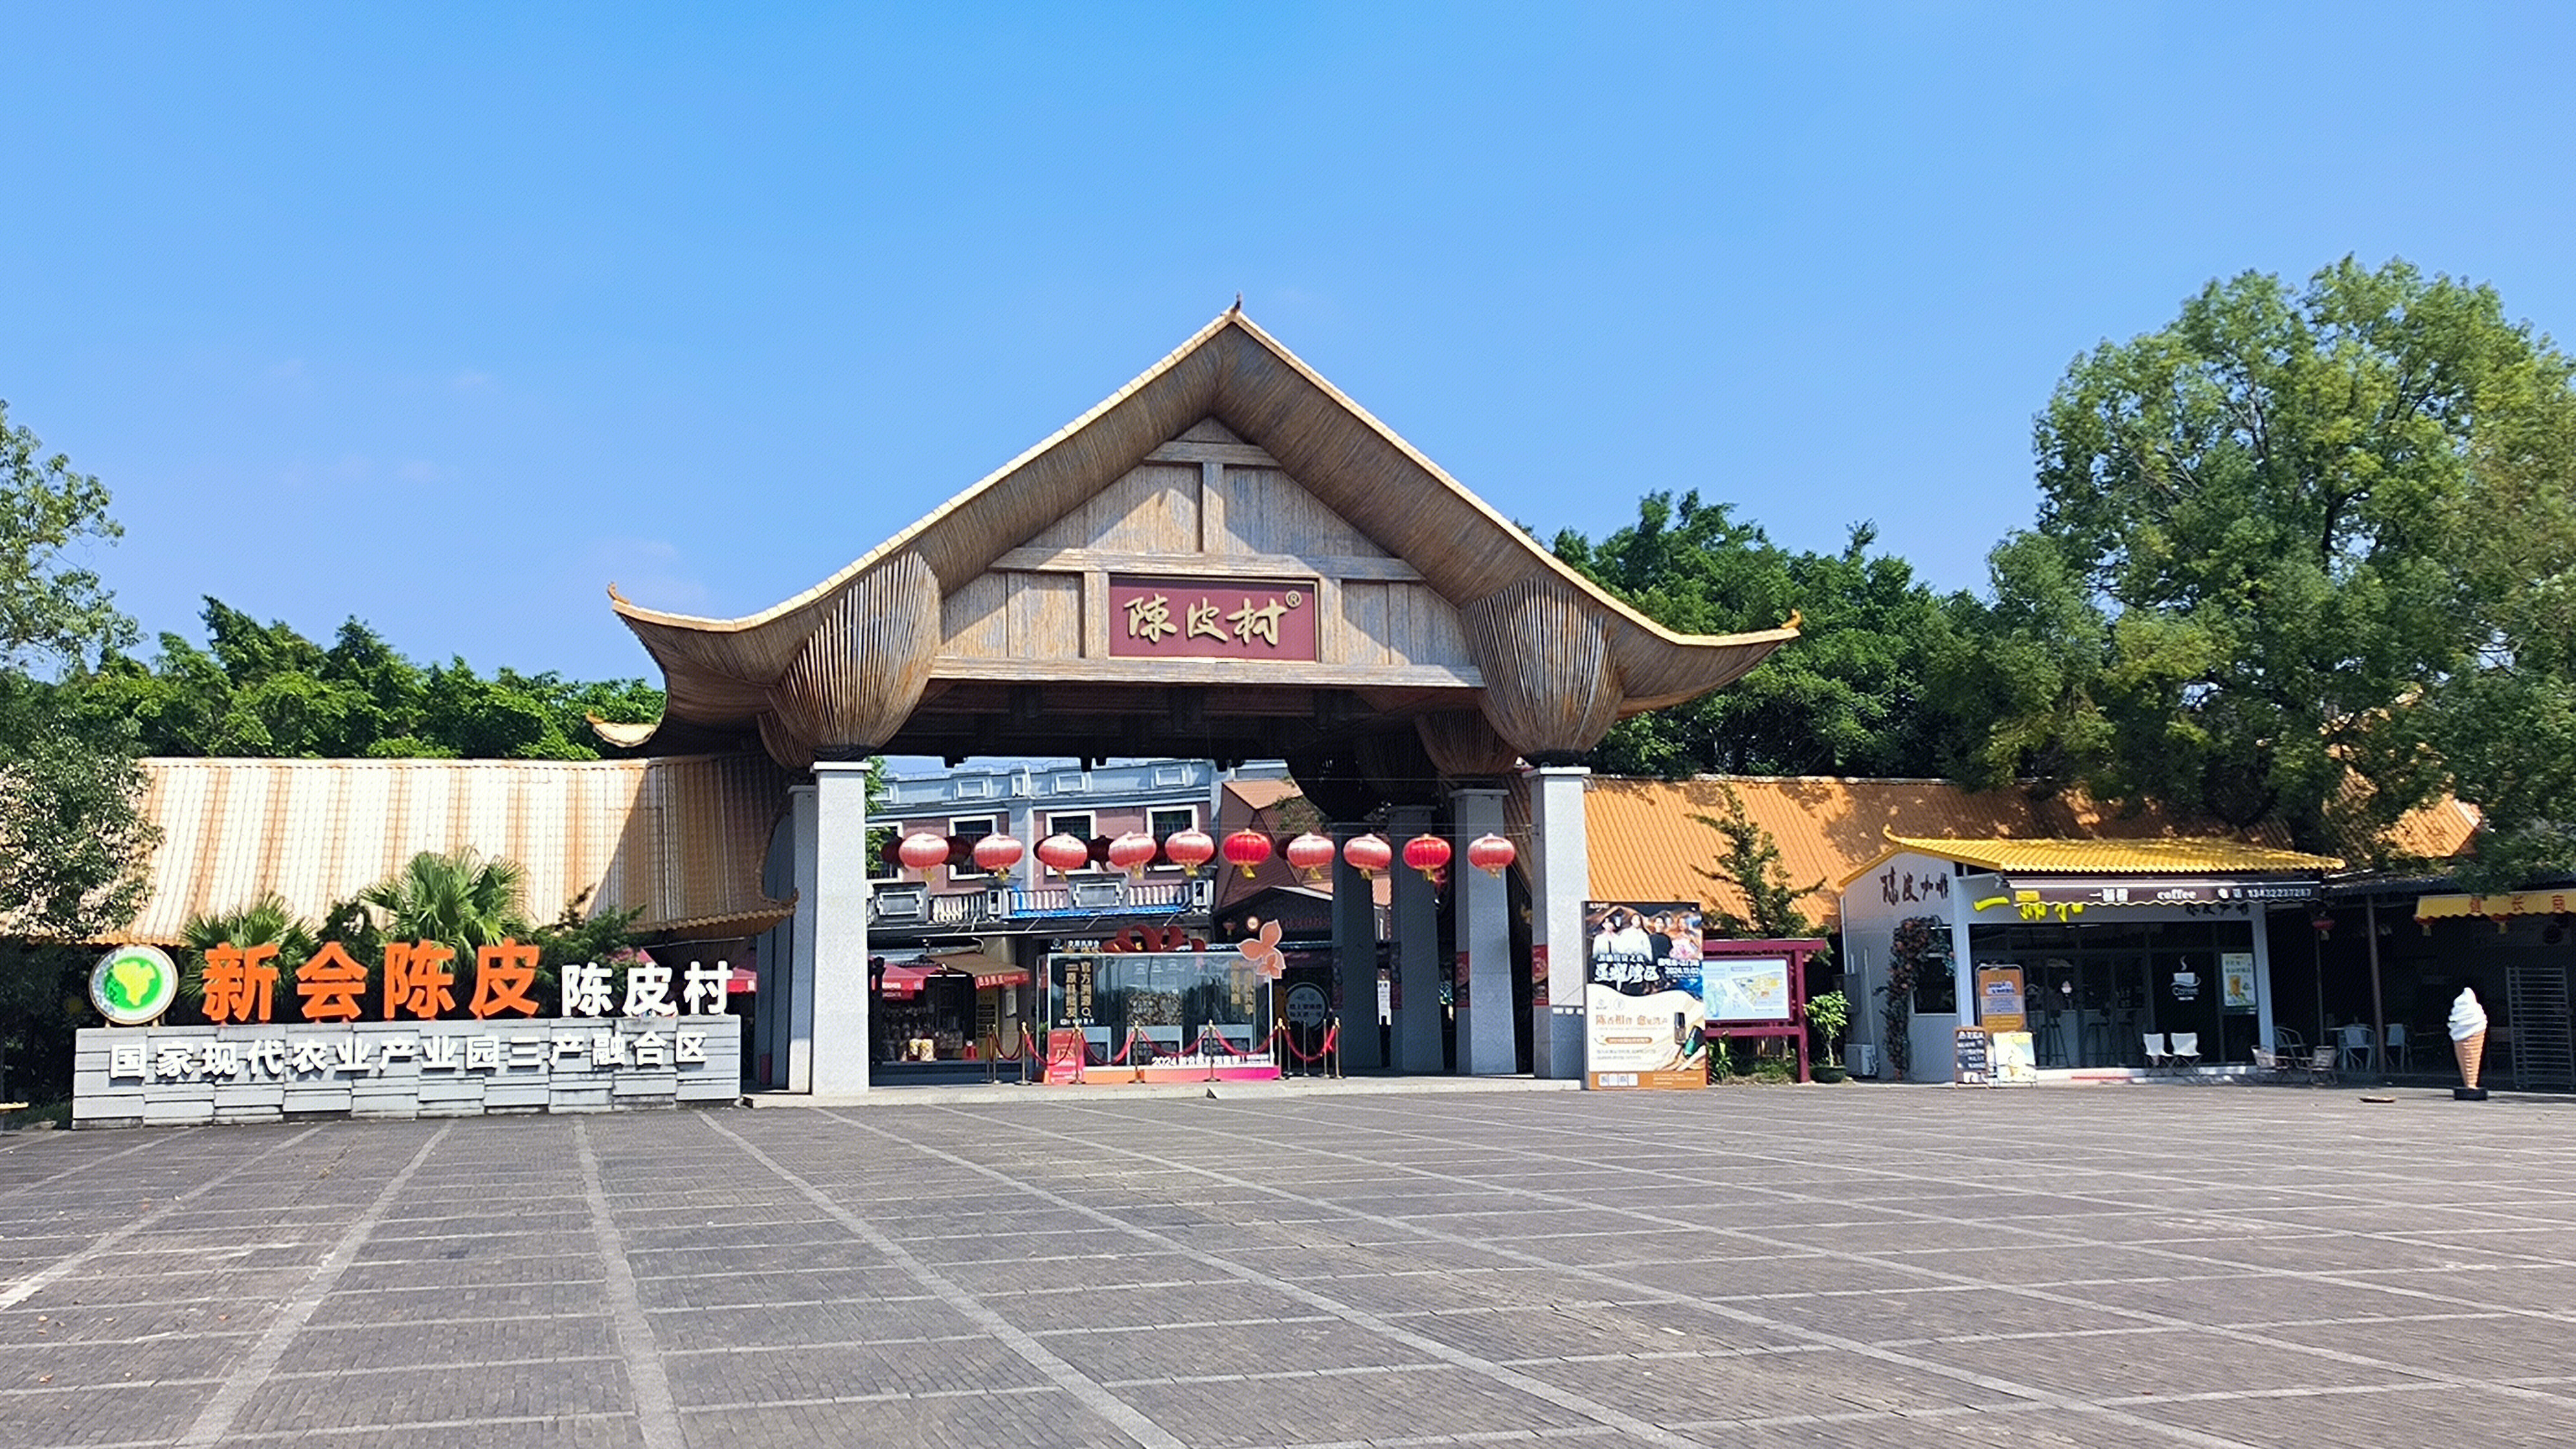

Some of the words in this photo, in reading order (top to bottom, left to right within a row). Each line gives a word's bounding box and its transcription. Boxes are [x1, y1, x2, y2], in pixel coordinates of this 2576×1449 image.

[2157, 888, 2198, 900] coffee
[202, 937, 539, 1022] 新会陈皮
[561, 960, 734, 1018] 陈皮村
[109, 1030, 708, 1080] 国家现代农业产业园三产融合区
